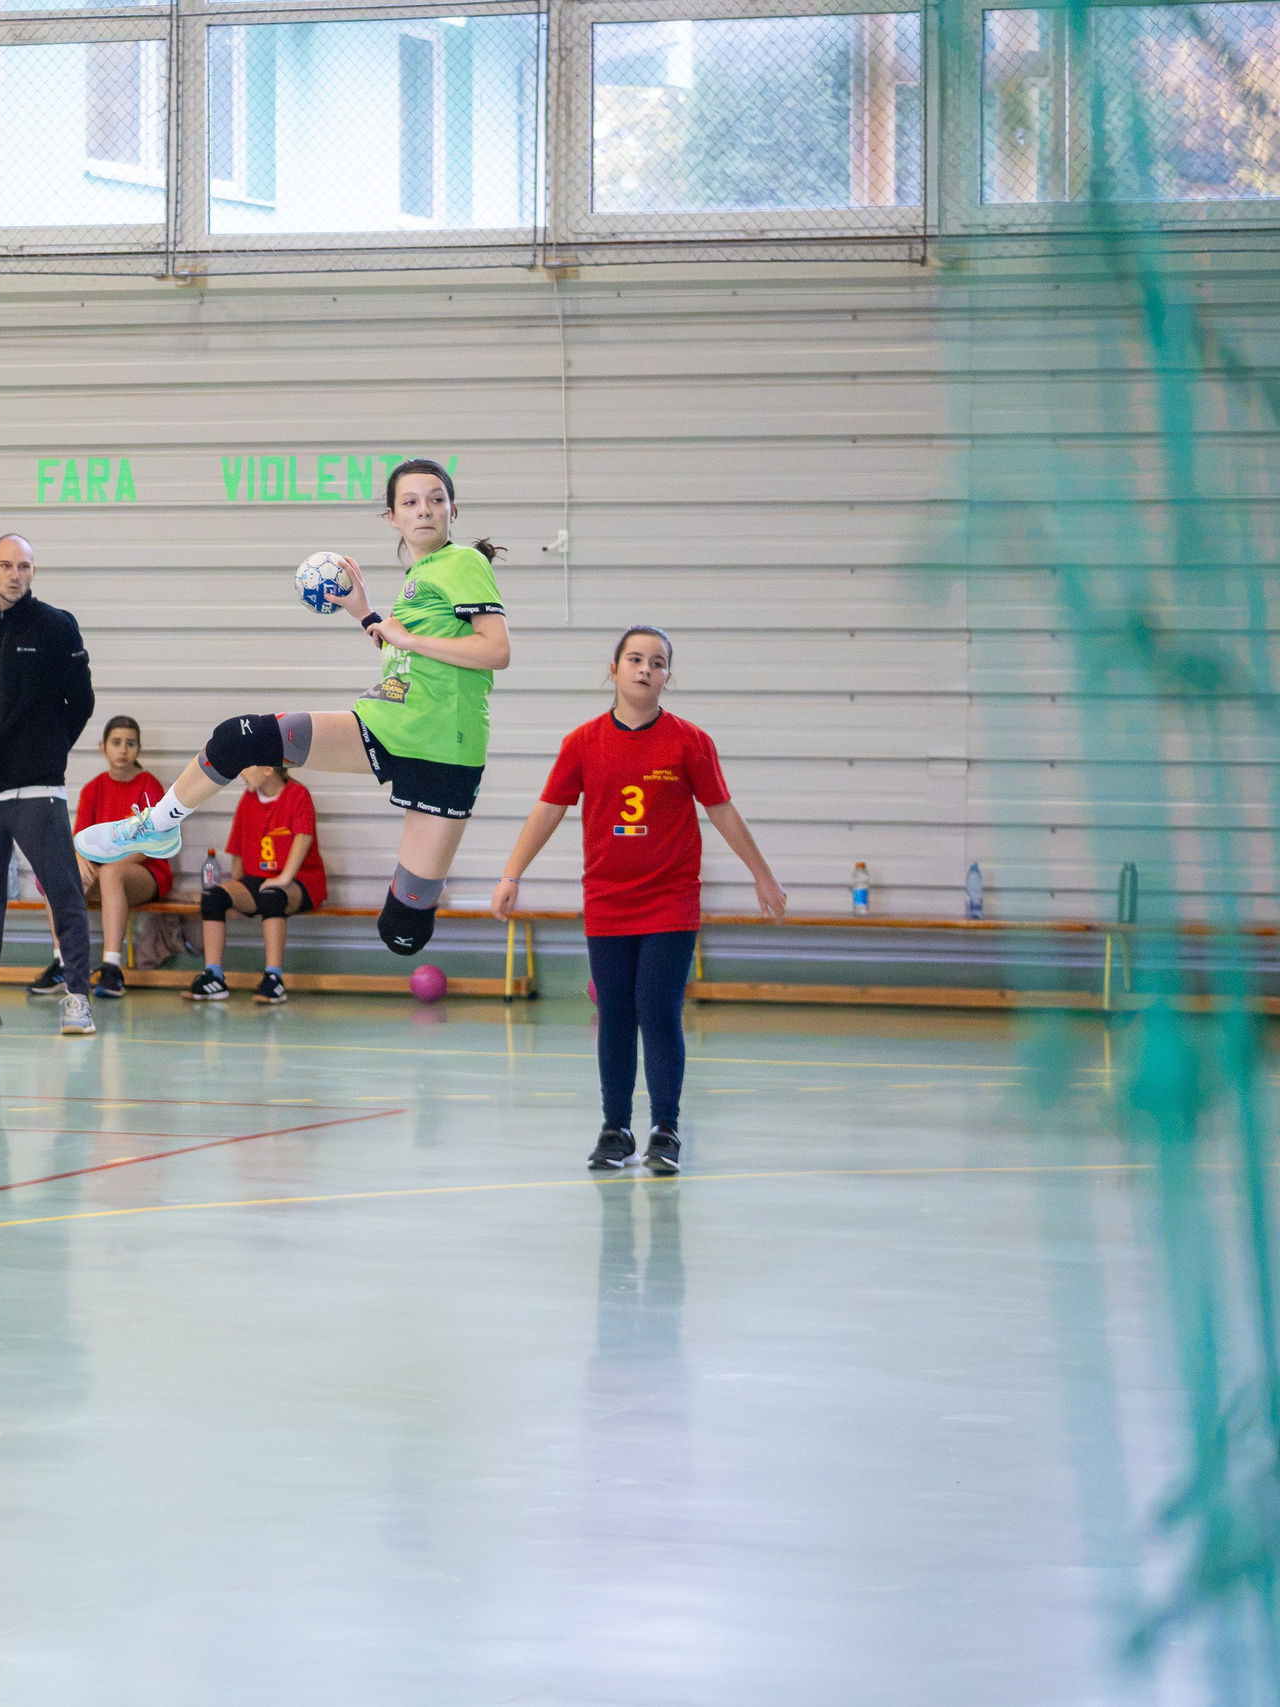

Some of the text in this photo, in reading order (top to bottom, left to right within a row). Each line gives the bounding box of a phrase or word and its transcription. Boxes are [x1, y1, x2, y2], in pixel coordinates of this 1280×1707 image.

[37, 457, 138, 503] FARA
[368, 748, 381, 771] Kempa
[417, 801, 441, 814] Kempa
[620, 785, 645, 823] 3
[260, 836, 275, 861] 8
